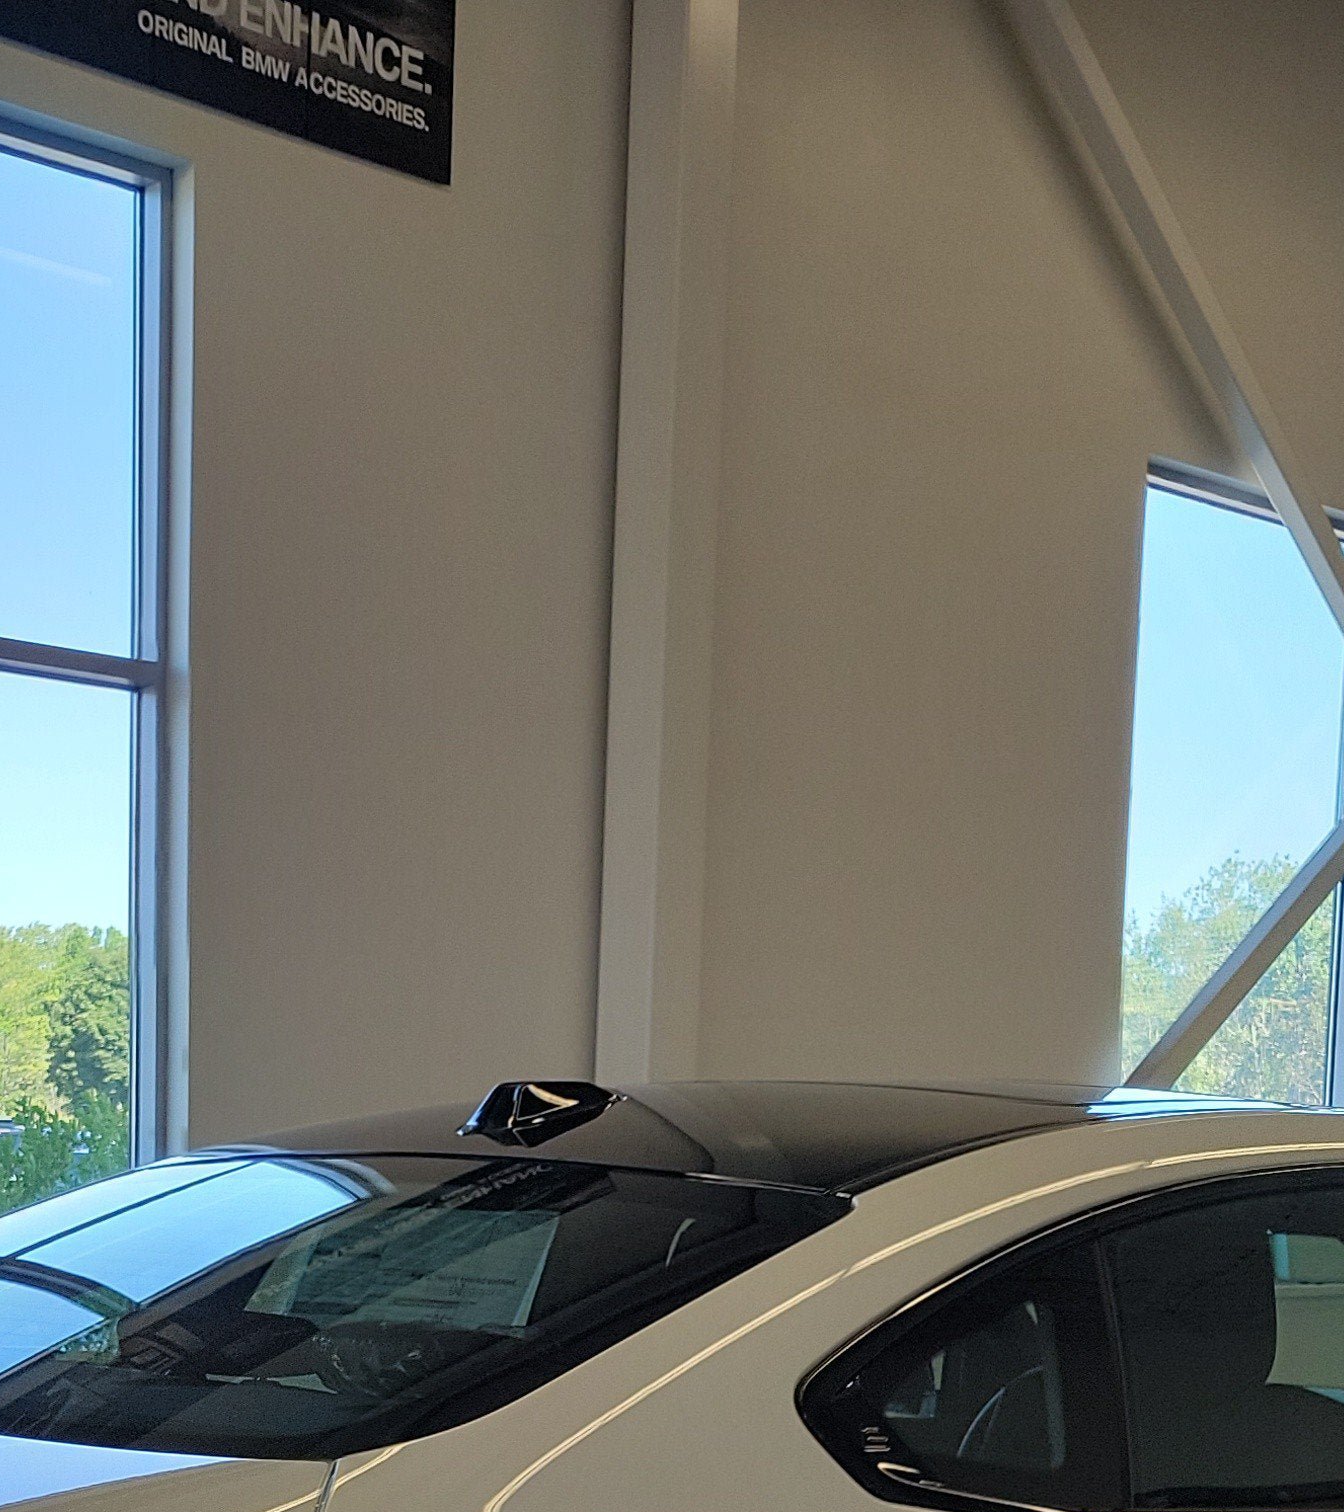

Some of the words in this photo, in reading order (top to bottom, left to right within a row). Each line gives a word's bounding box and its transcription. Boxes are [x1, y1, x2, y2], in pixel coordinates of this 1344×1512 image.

[136, 9, 233, 64] ORIGINAL
[241, 47, 290, 83] BMW
[294, 66, 430, 132] ACCESSORIES.
[240, 0, 433, 94] ENHANCE.
